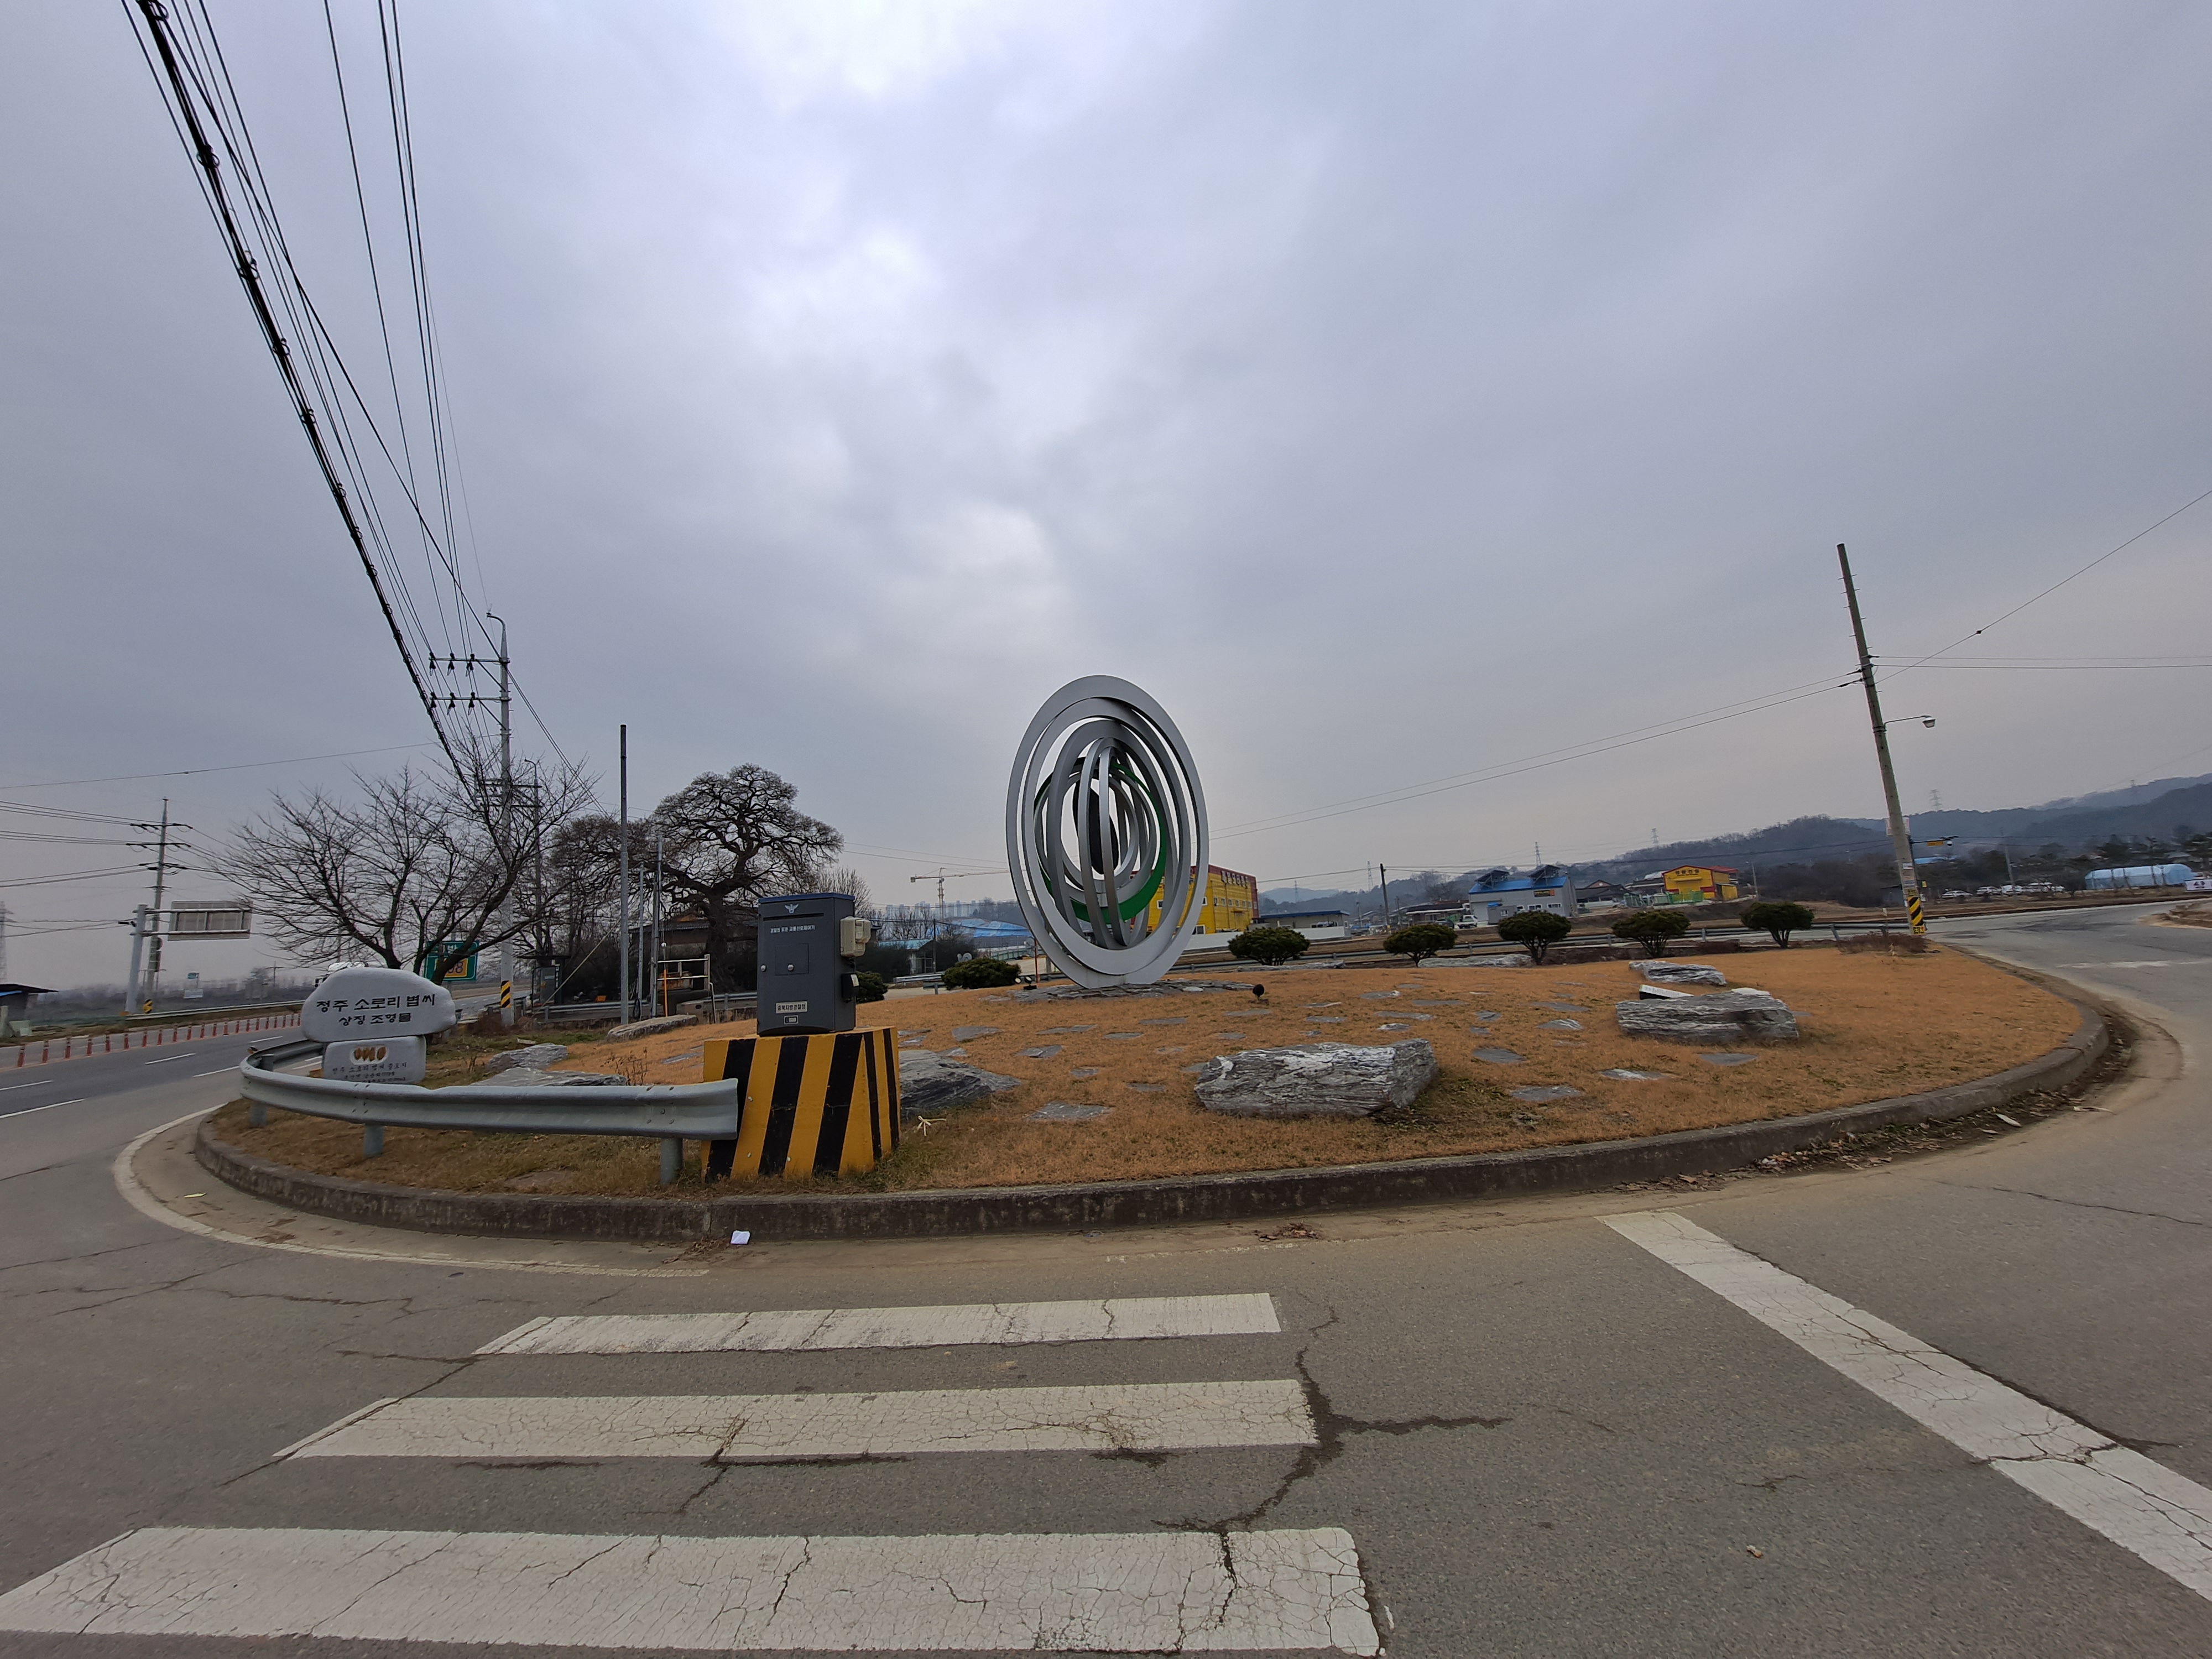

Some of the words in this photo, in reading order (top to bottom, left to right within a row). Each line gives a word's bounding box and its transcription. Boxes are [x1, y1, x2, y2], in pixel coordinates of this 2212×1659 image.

[354, 996, 400, 1011] 소로리
[406, 993, 436, 1008] 볍씨
[338, 1015, 366, 1027] 상징
[371, 1013, 411, 1024] 조형물
